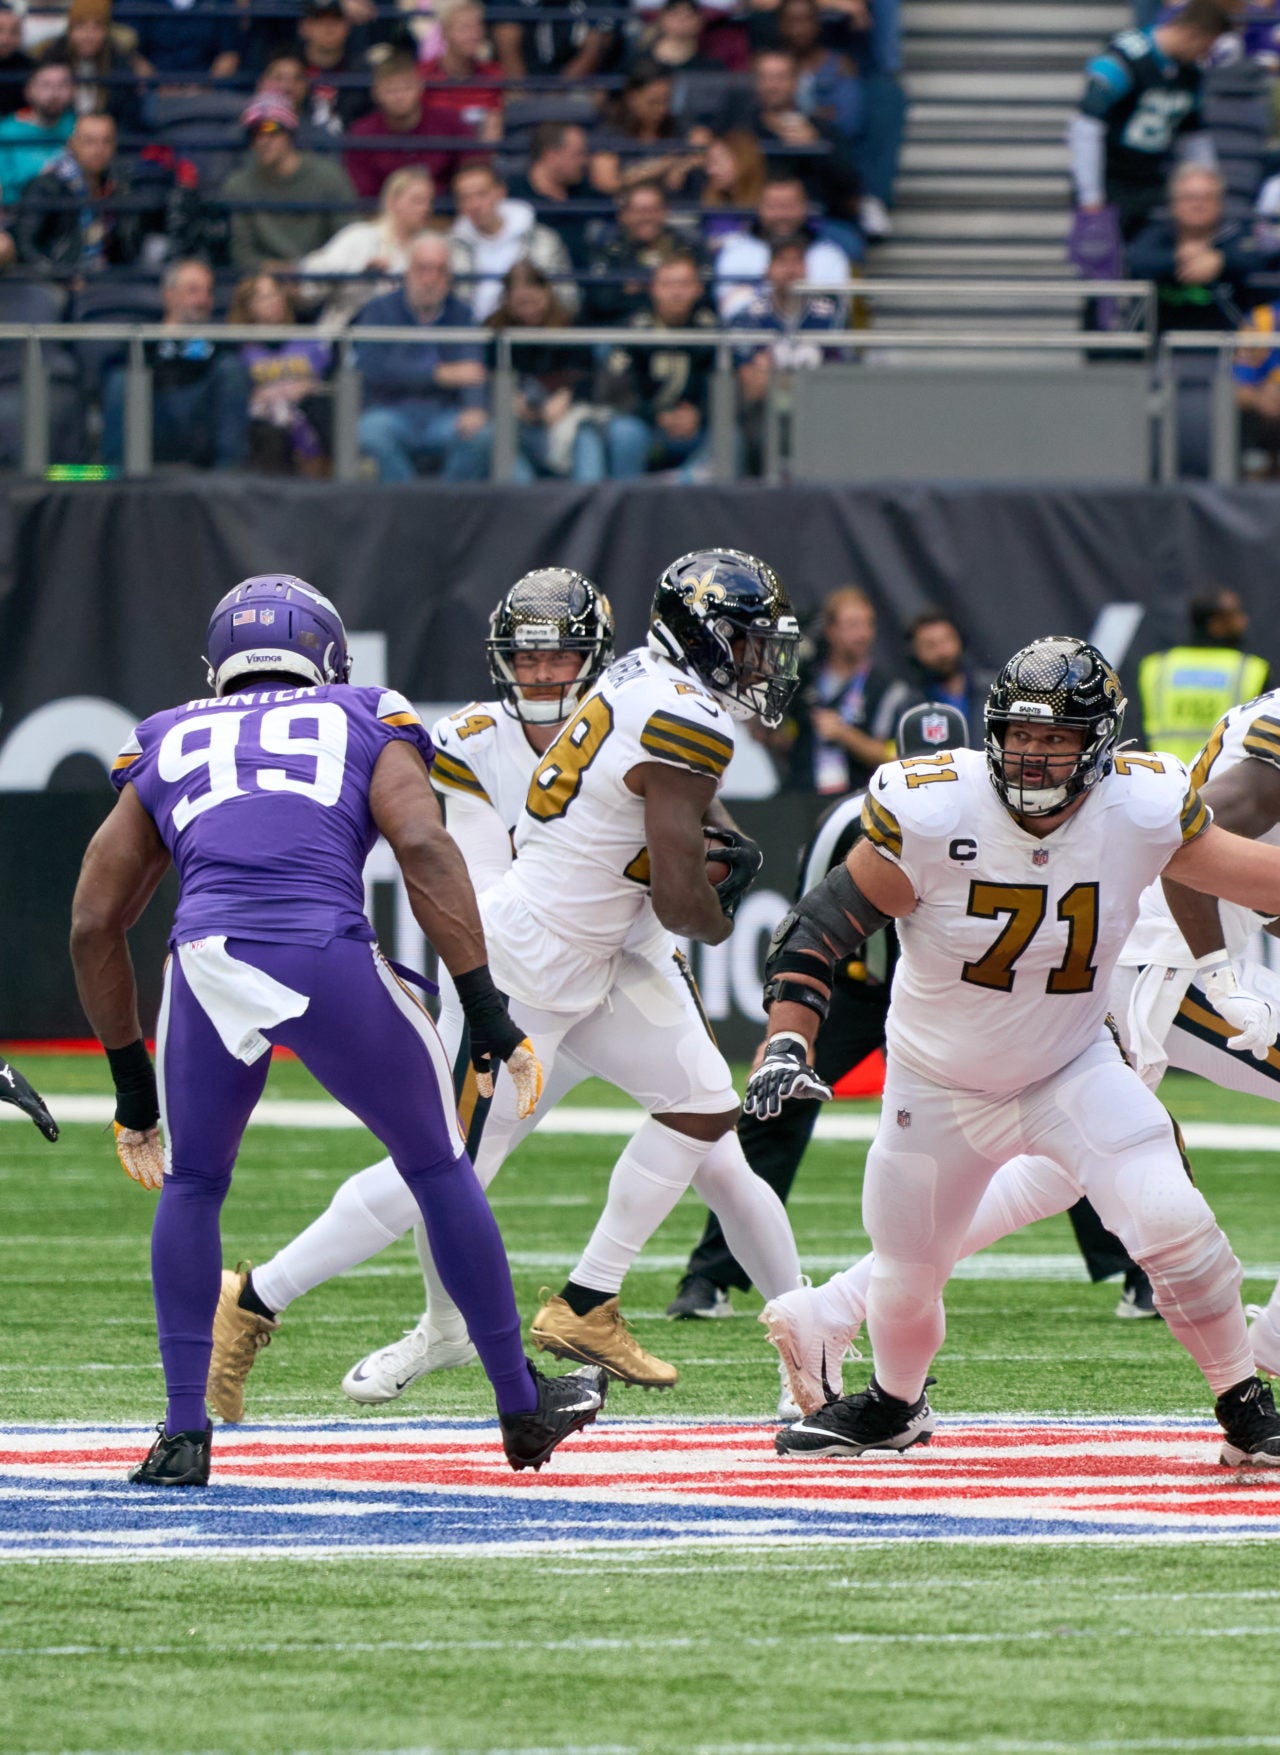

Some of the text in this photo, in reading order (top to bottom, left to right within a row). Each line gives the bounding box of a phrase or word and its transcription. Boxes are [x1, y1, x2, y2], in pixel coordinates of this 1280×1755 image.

[157, 701, 348, 832] 99
[524, 691, 615, 824] 8
[1019, 705, 1042, 714] SAINTS
[948, 838, 977, 862] C
[961, 878, 1100, 995] 71
